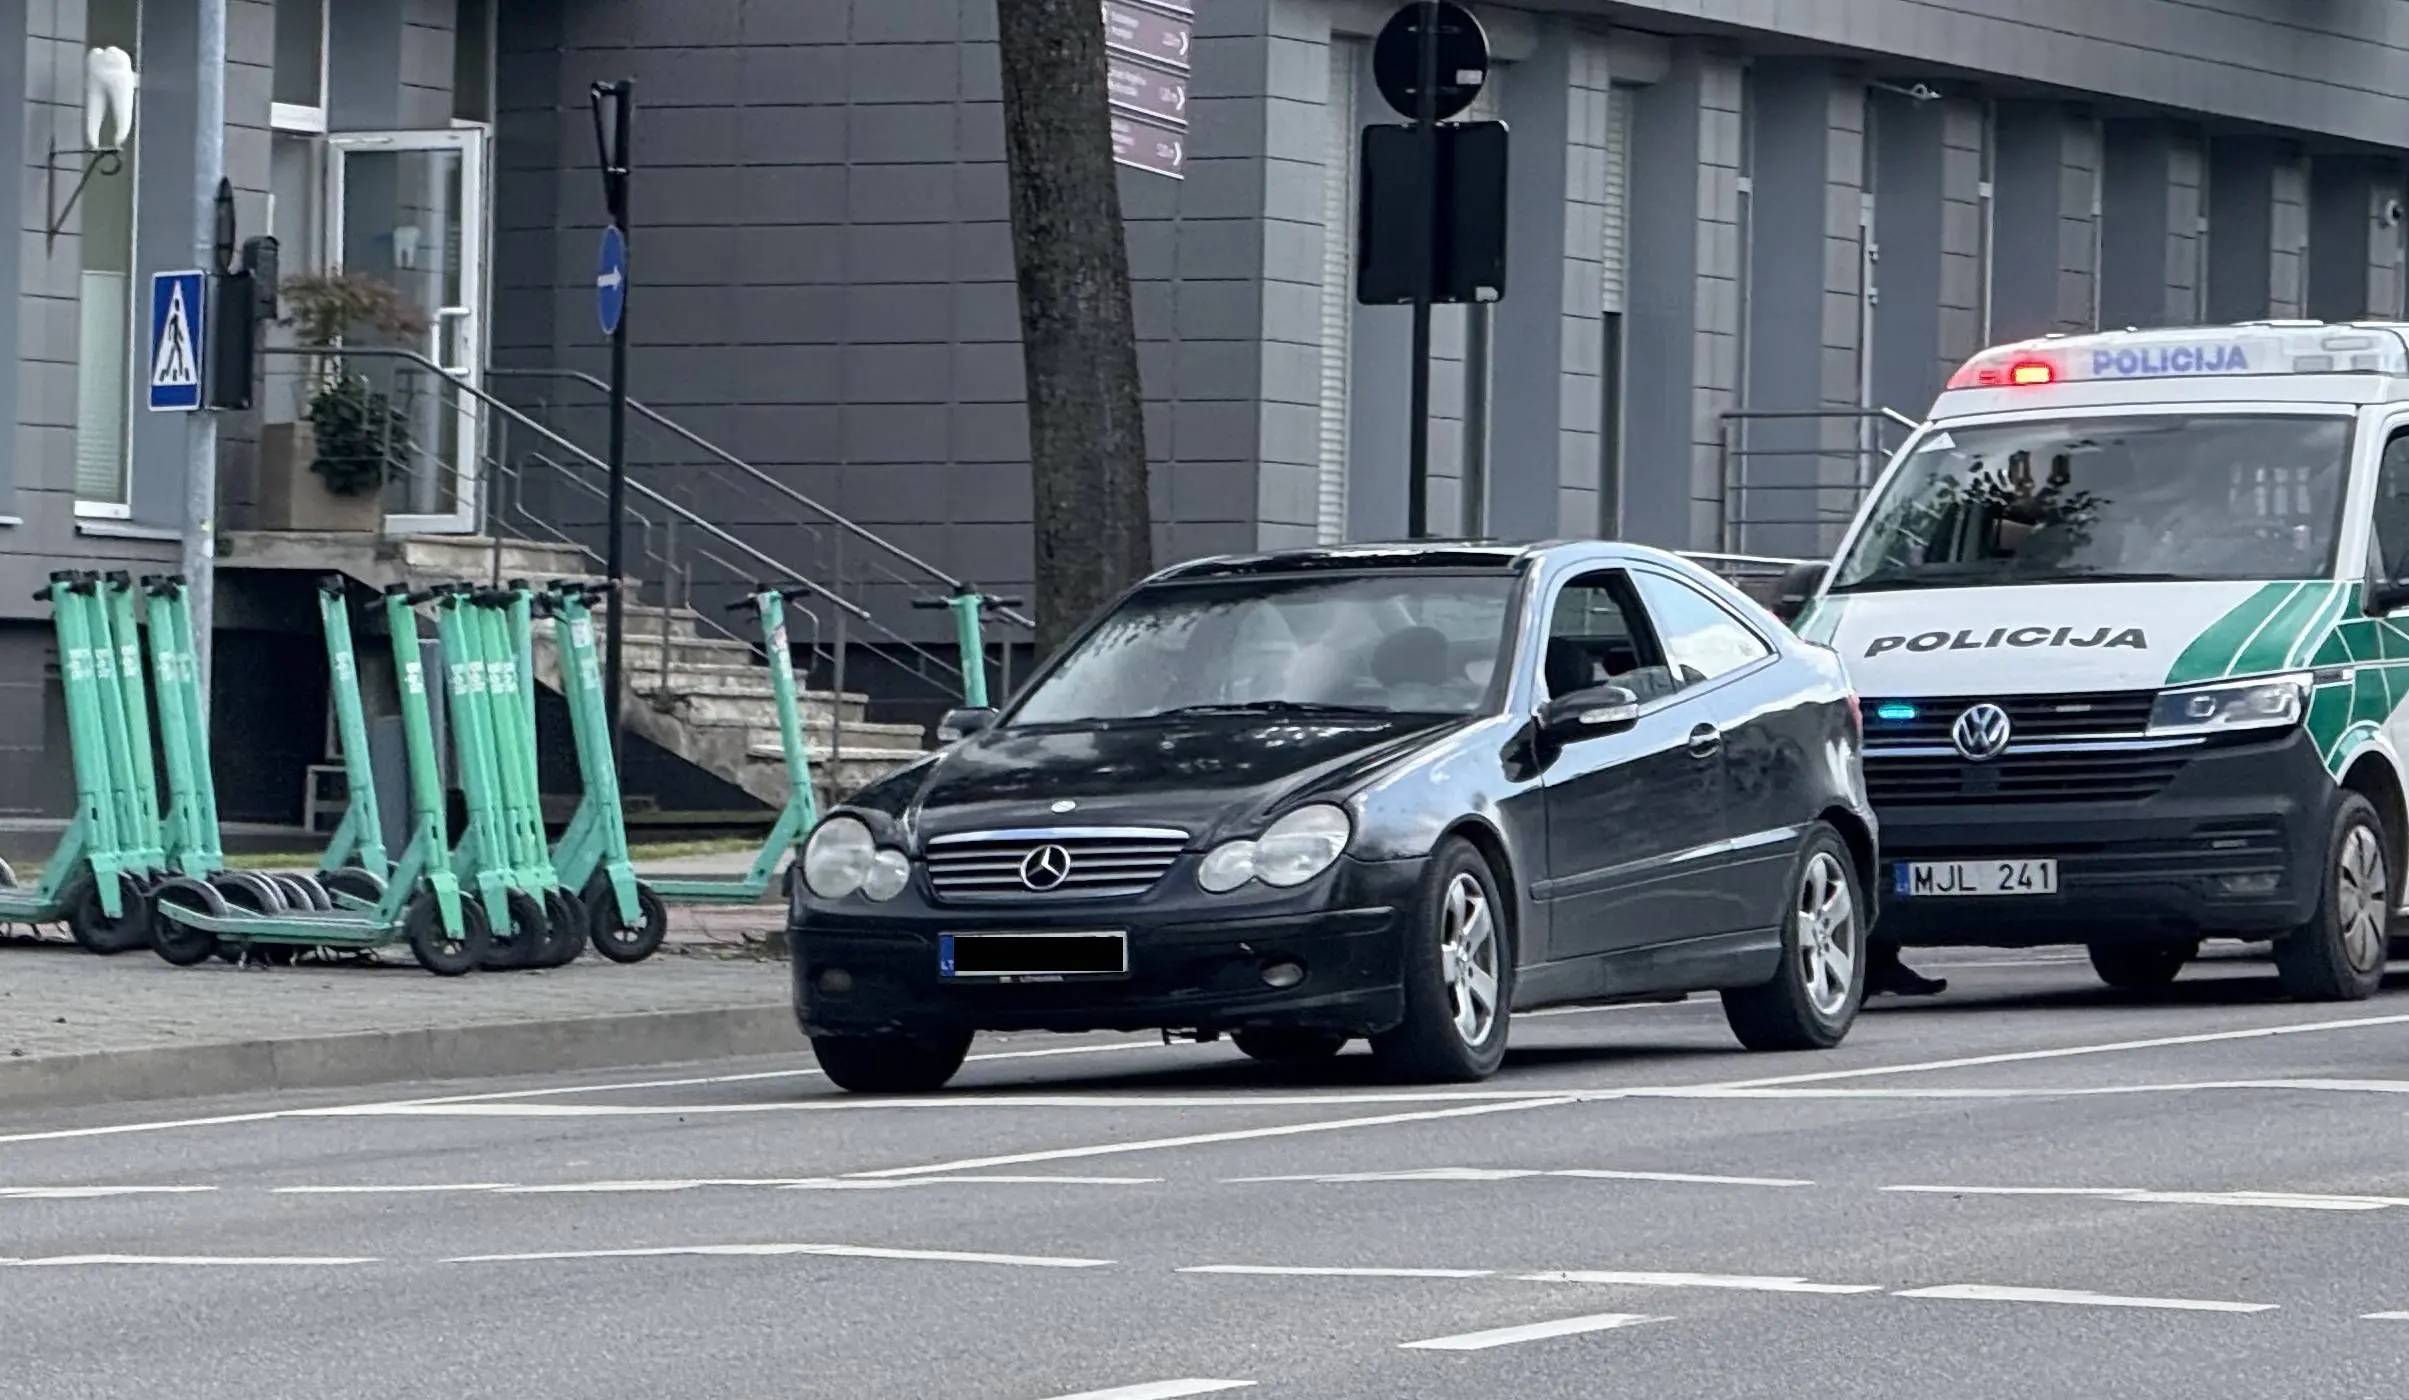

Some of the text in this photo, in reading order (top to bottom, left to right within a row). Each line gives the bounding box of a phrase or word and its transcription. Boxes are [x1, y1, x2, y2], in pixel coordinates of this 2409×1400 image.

[2092, 345, 2249, 375] POLICIJA
[1864, 626, 2148, 658] POLICIJA
[1914, 862, 2049, 893] MJL 241
